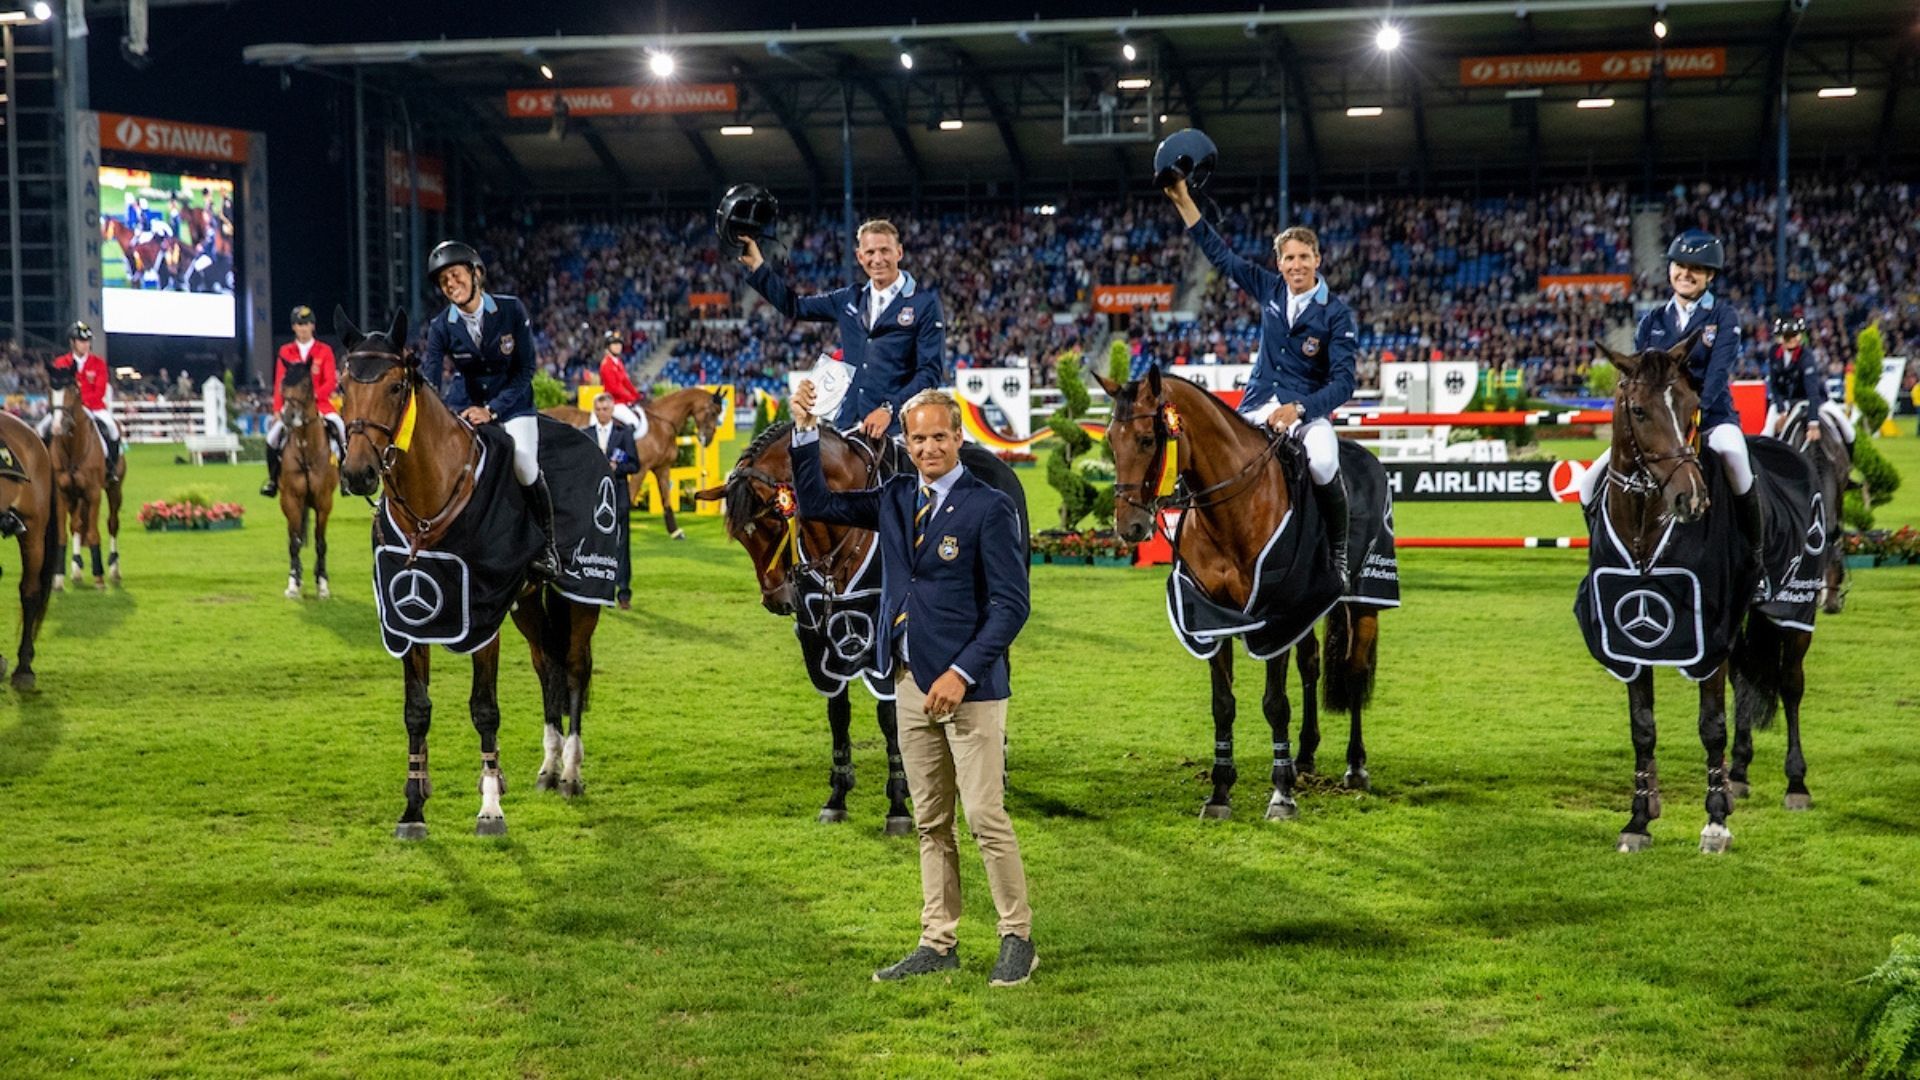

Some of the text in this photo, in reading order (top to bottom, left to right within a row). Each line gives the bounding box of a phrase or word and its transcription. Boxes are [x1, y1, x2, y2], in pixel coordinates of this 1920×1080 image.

[1498, 59, 1582, 79] STAWAG
[1628, 53, 1716, 72] STWAG
[653, 90, 728, 108] STAWAG
[145, 124, 233, 157] STAWAG
[83, 150, 100, 317] AACHEN
[1414, 470, 1542, 493] AIRLINES
